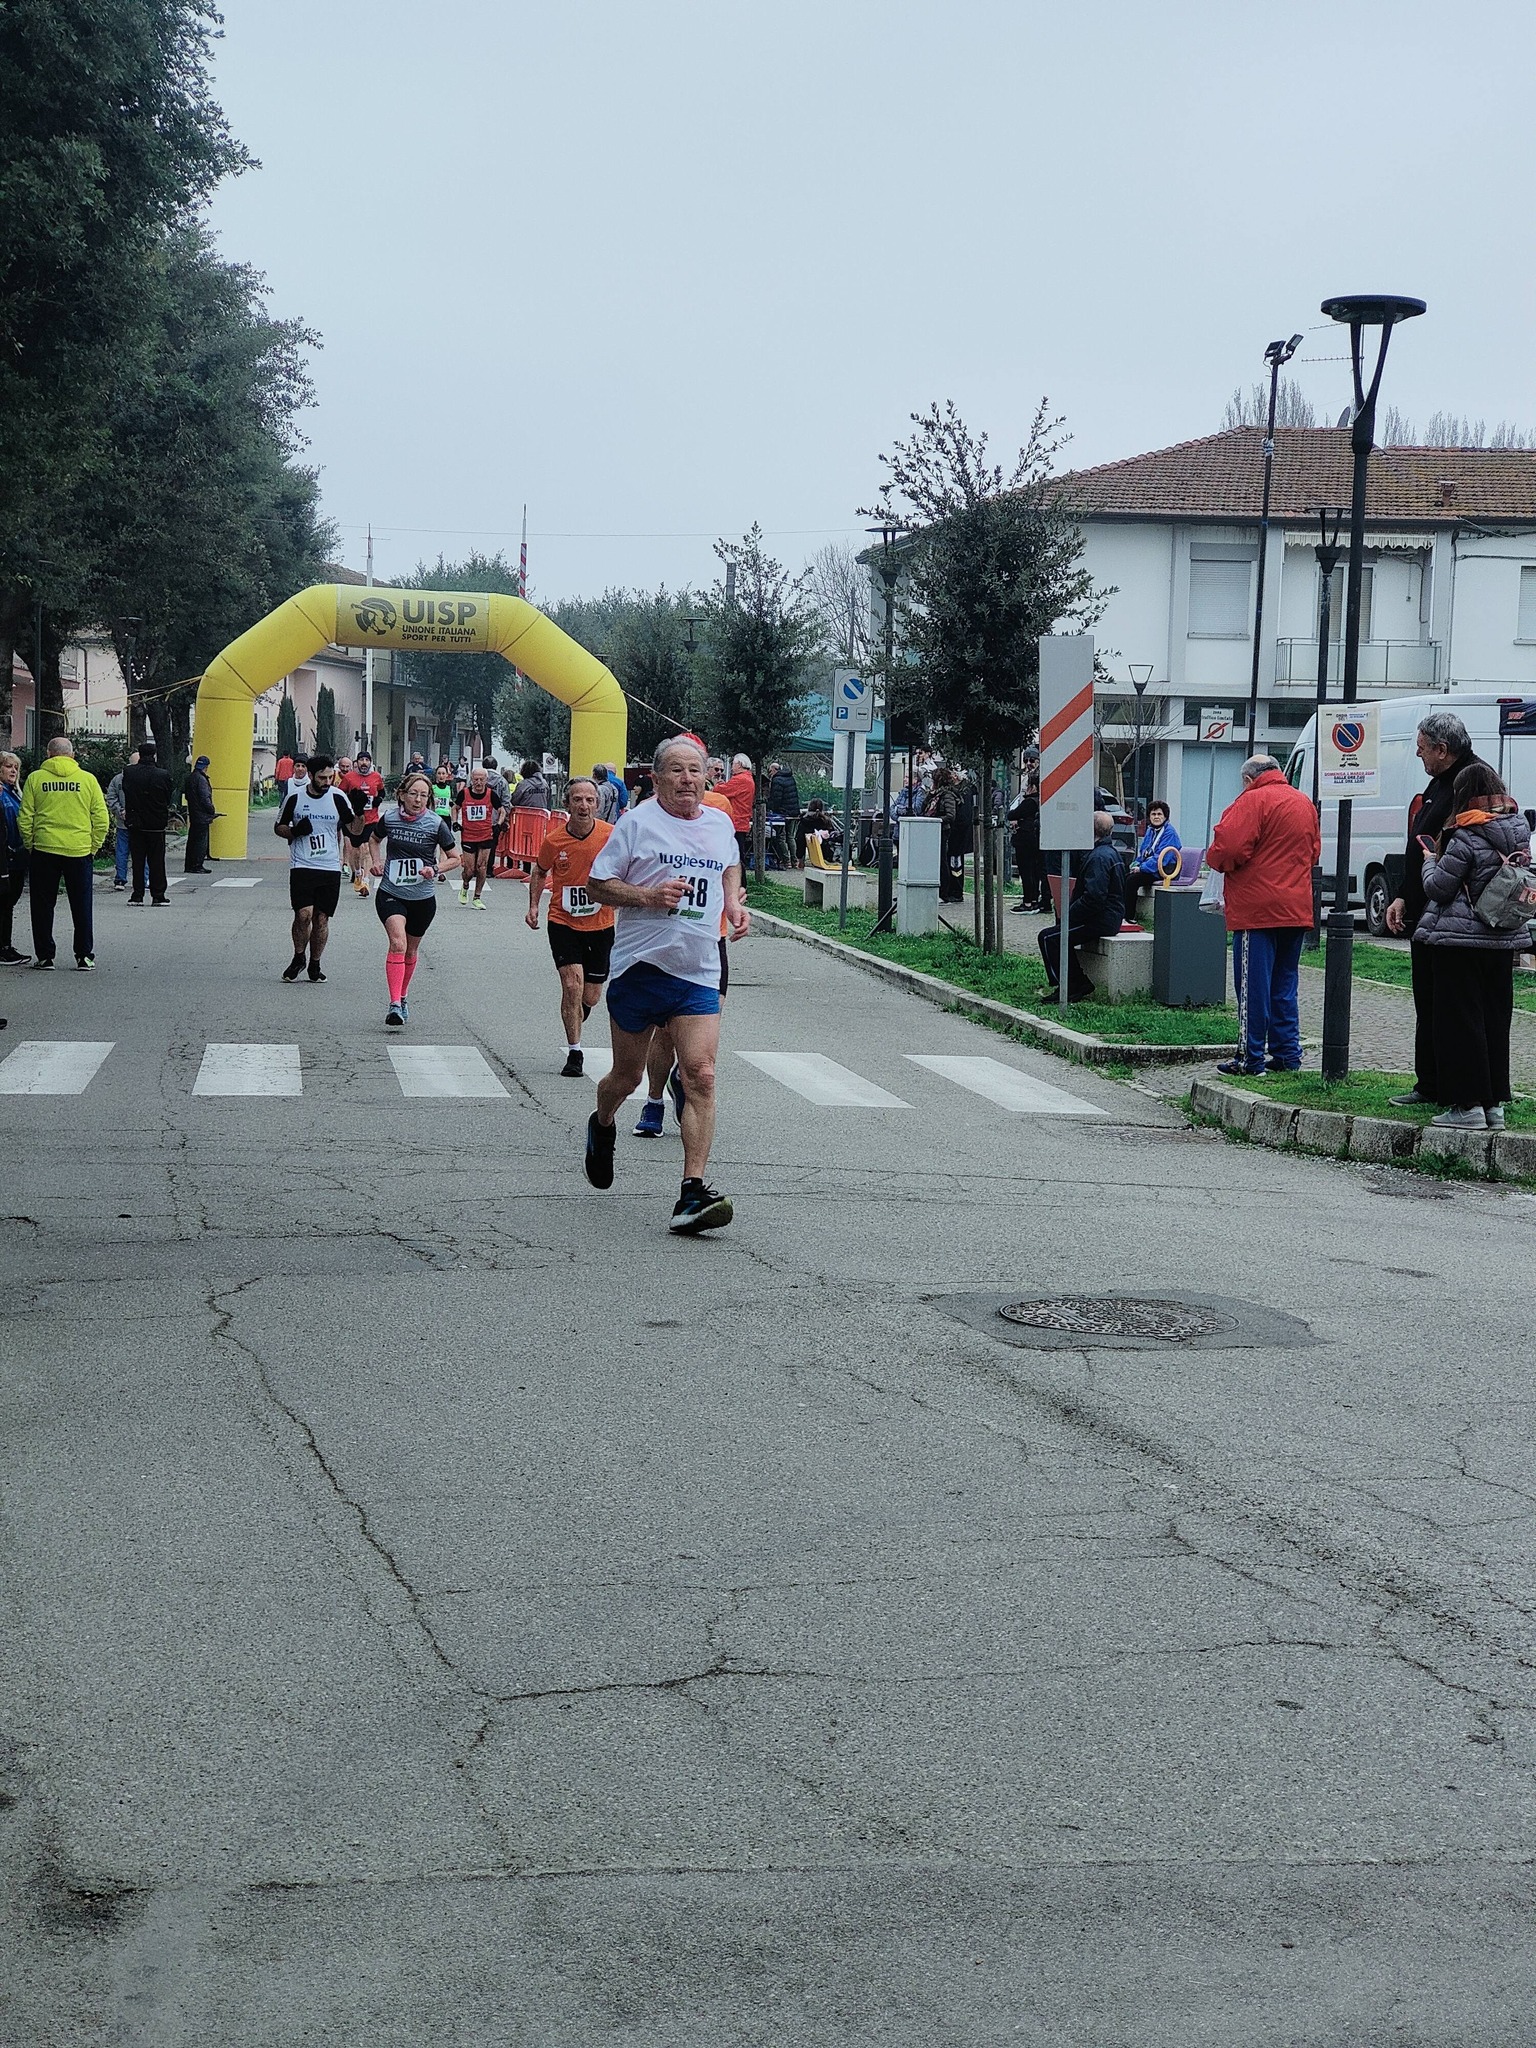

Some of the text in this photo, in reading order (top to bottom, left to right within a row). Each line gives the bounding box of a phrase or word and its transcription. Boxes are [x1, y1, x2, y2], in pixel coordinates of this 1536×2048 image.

[403, 599, 476, 625] UISP
[402, 625, 476, 636] UNIONE ITALIANA
[450, 635, 471, 643] TUTTI
[838, 708, 846, 718] P
[42, 781, 81, 792] GIUDICE
[391, 829, 427, 838] ATLETICA
[392, 834, 423, 844] MAMELI
[309, 834, 325, 850] 617
[398, 859, 417, 877] 719
[570, 887, 595, 907] 66
[679, 875, 708, 908] 48
